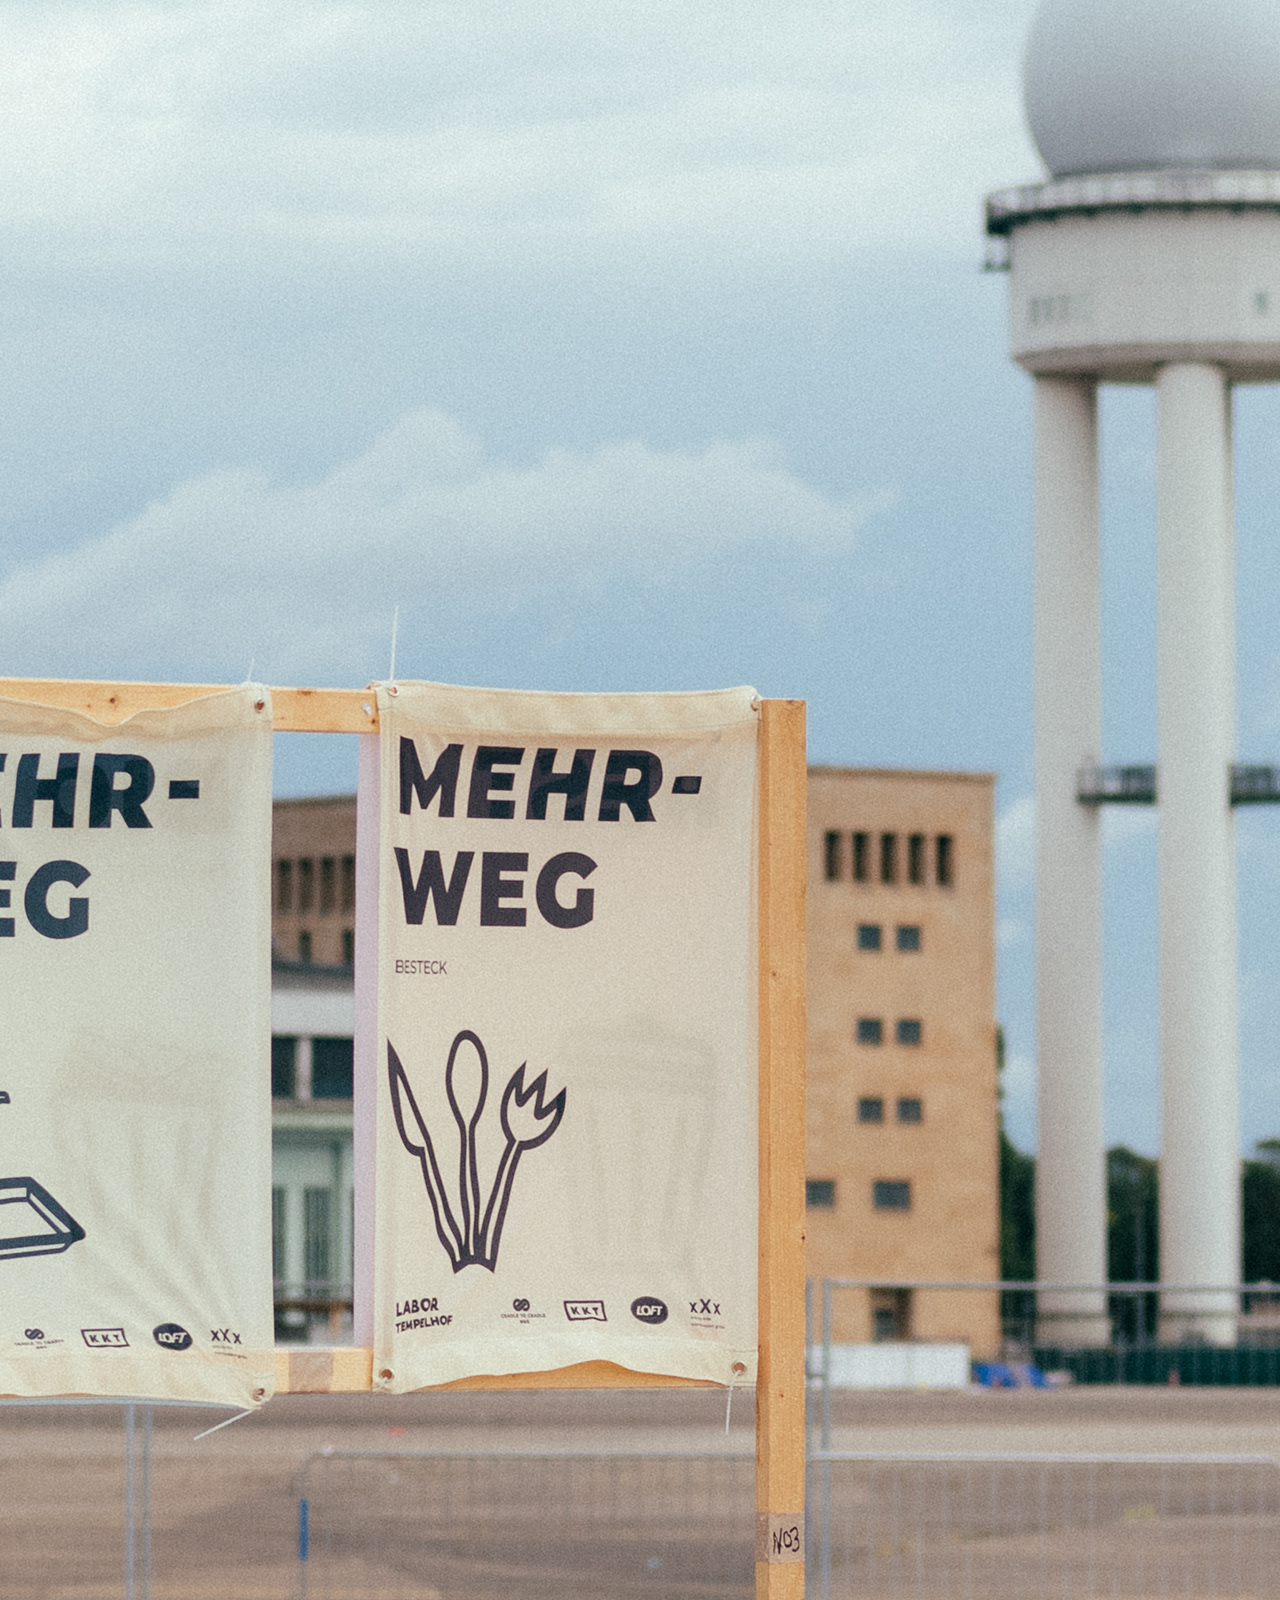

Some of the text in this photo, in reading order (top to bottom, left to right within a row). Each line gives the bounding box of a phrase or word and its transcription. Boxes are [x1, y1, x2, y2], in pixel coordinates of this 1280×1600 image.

[399, 736, 702, 823] MEHR-
[394, 846, 598, 929] WEG
[395, 960, 447, 975] BESTECK
[396, 1297, 439, 1317] LABOR
[636, 1305, 663, 1316] LOFT
[396, 1315, 453, 1333] TEMPELHOF
[158, 1332, 187, 1343] LOFT
